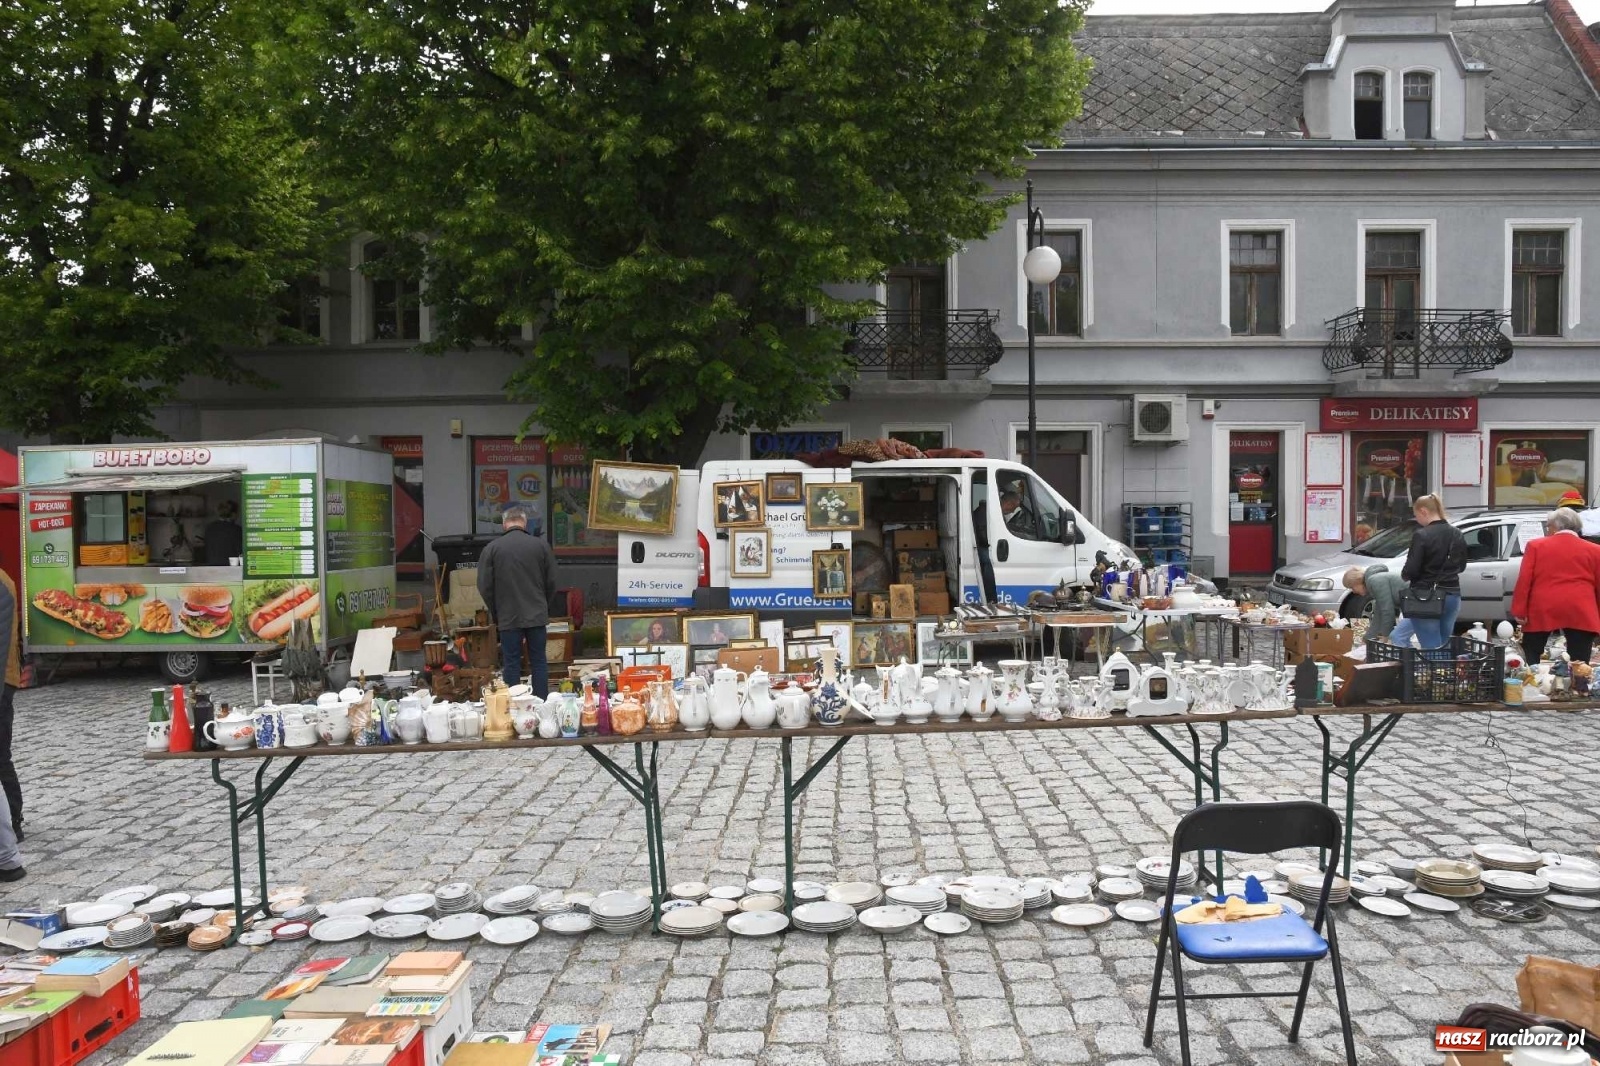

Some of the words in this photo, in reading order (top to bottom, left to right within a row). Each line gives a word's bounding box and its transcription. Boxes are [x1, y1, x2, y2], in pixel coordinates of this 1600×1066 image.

[1331, 409, 1359, 417] Premium
[1370, 406, 1473, 420] DELIKATESY
[93, 450, 151, 467] BUFET
[153, 448, 212, 466] BOBO
[34, 502, 67, 511] ZAPIEKANKI
[628, 580, 683, 590] 24h-Service
